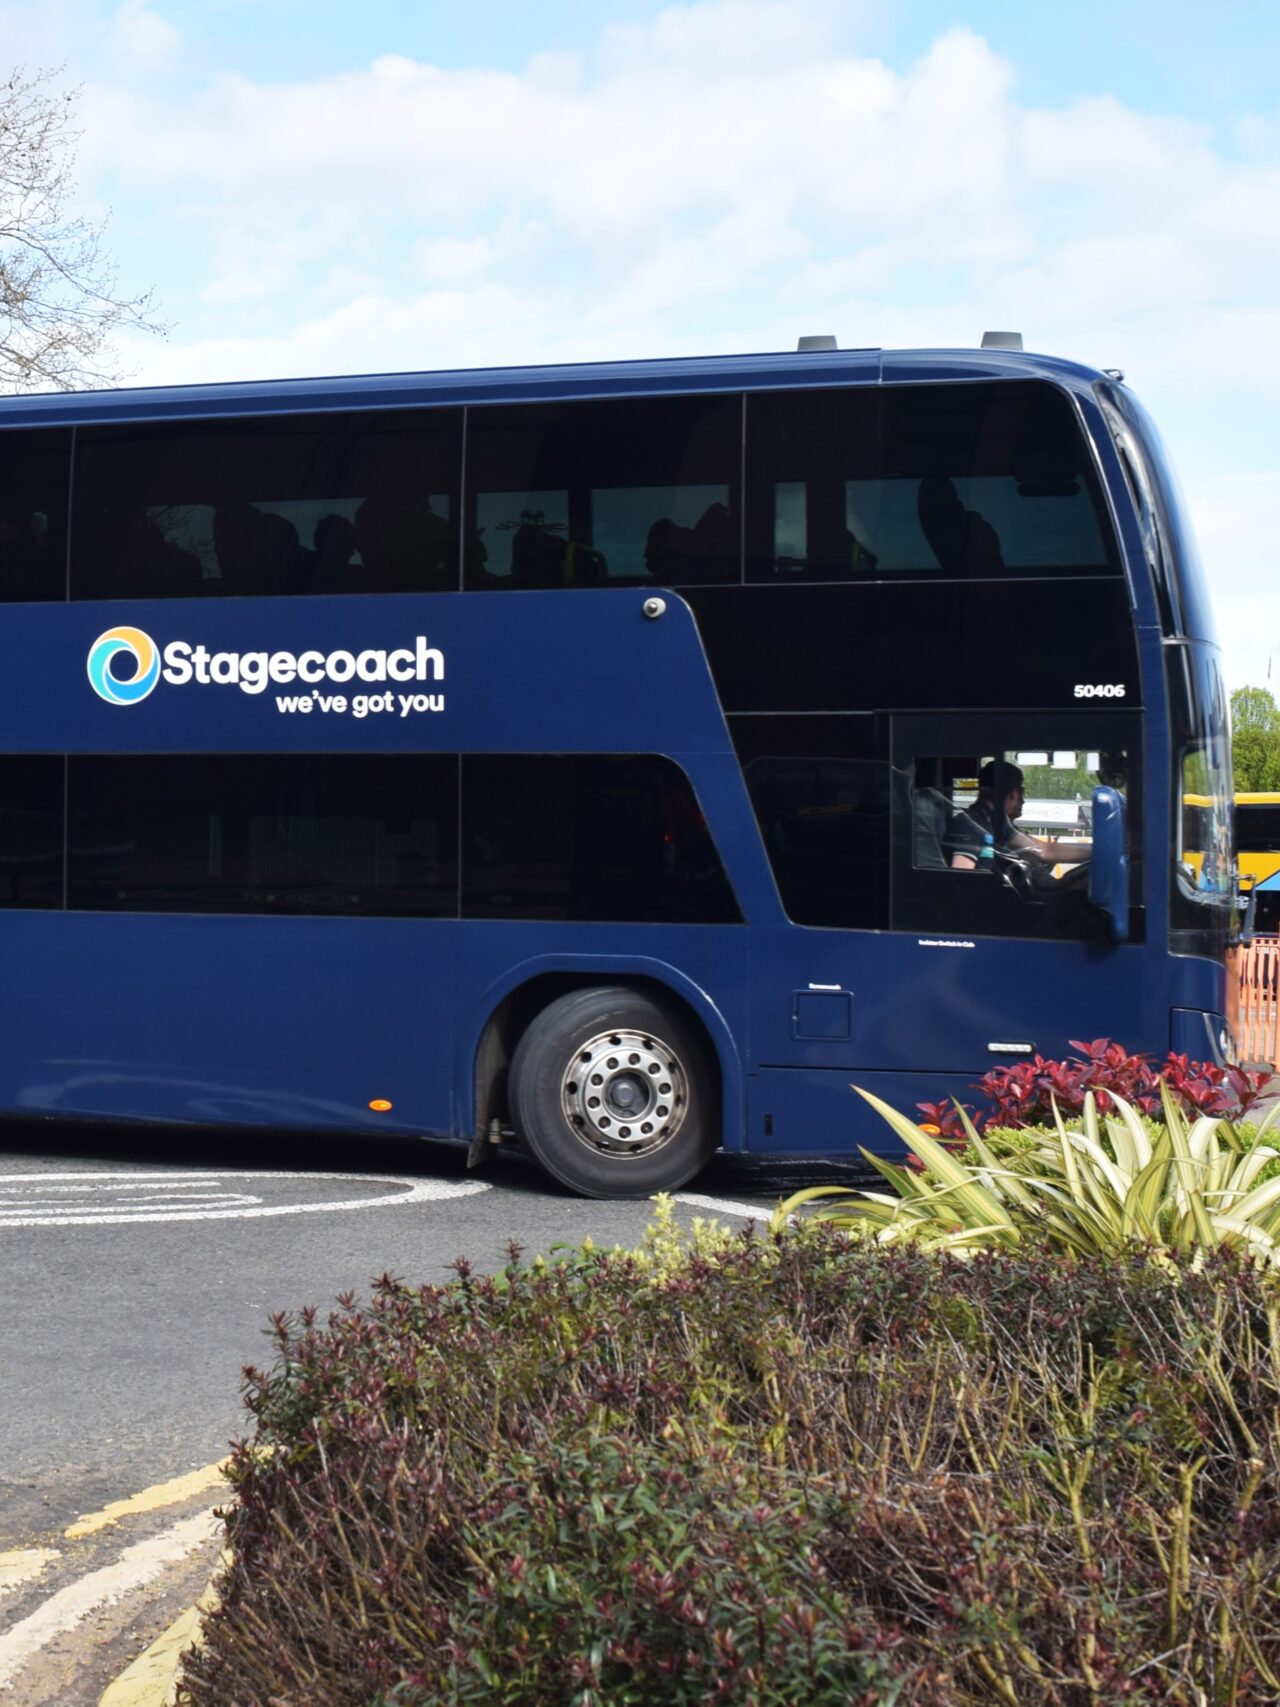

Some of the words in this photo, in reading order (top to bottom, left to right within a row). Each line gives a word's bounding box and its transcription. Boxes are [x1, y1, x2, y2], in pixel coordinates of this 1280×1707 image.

[162, 636, 445, 695] Stagecoach
[351, 691, 394, 718] got
[398, 694, 445, 718] you
[1073, 684, 1126, 698] 50406
